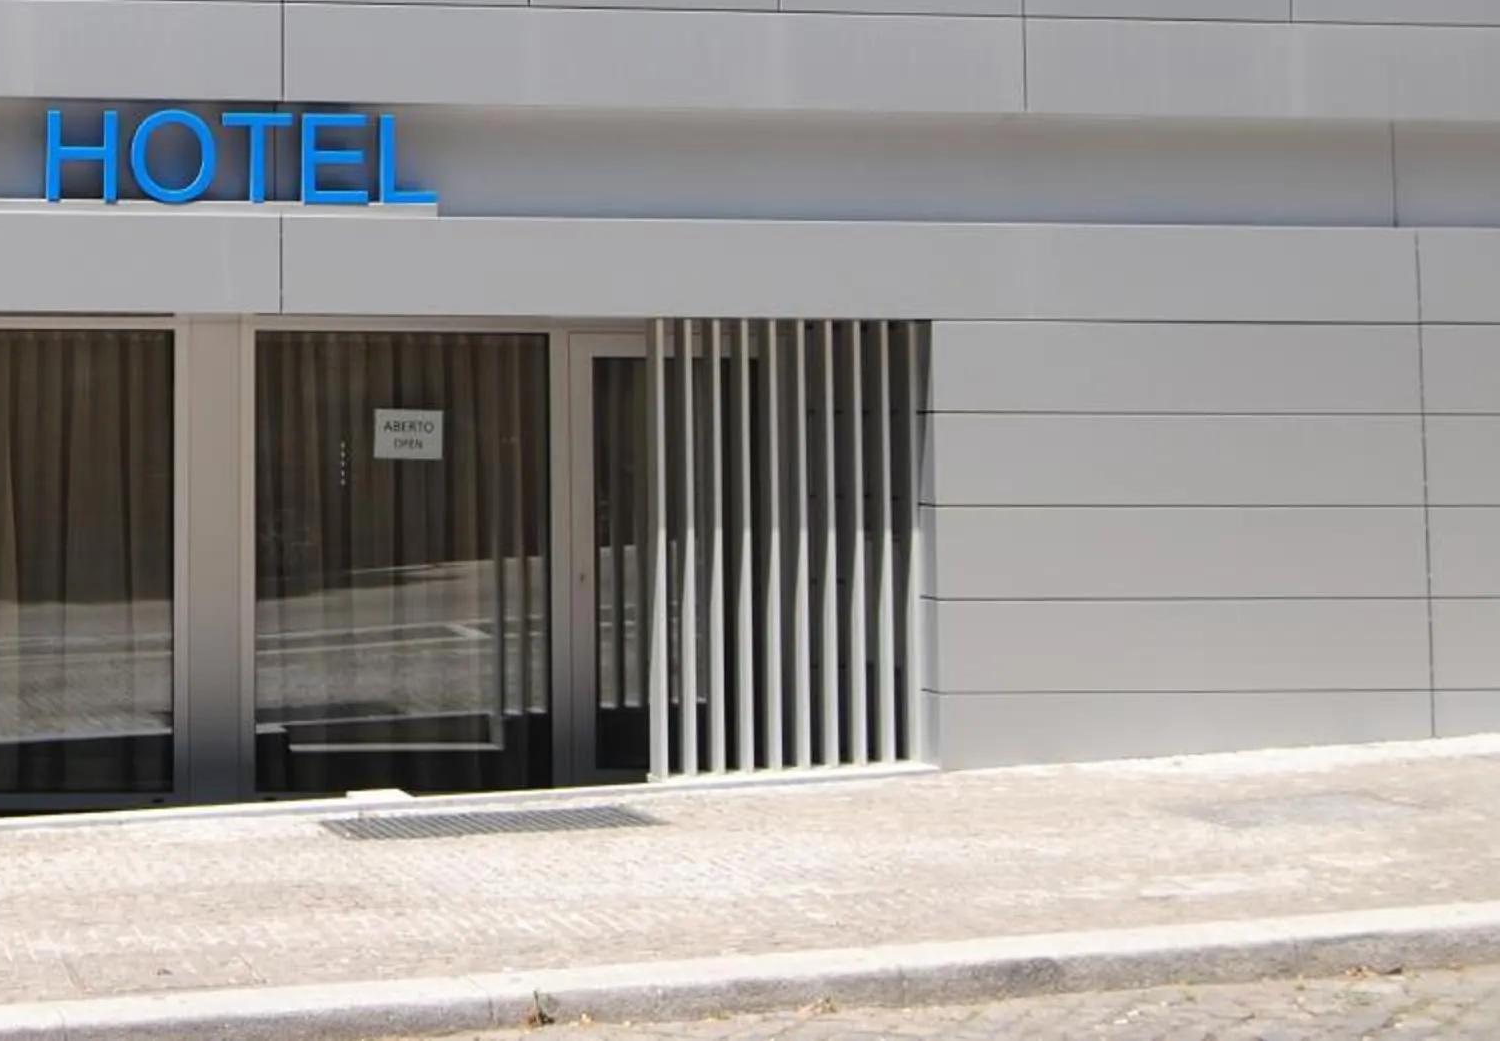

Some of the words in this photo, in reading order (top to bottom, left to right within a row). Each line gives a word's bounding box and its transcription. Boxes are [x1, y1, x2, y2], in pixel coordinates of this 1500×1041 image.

[44, 108, 439, 205] HOTEL
[383, 420, 435, 434] ABERTO
[393, 438, 423, 450] OPEN
